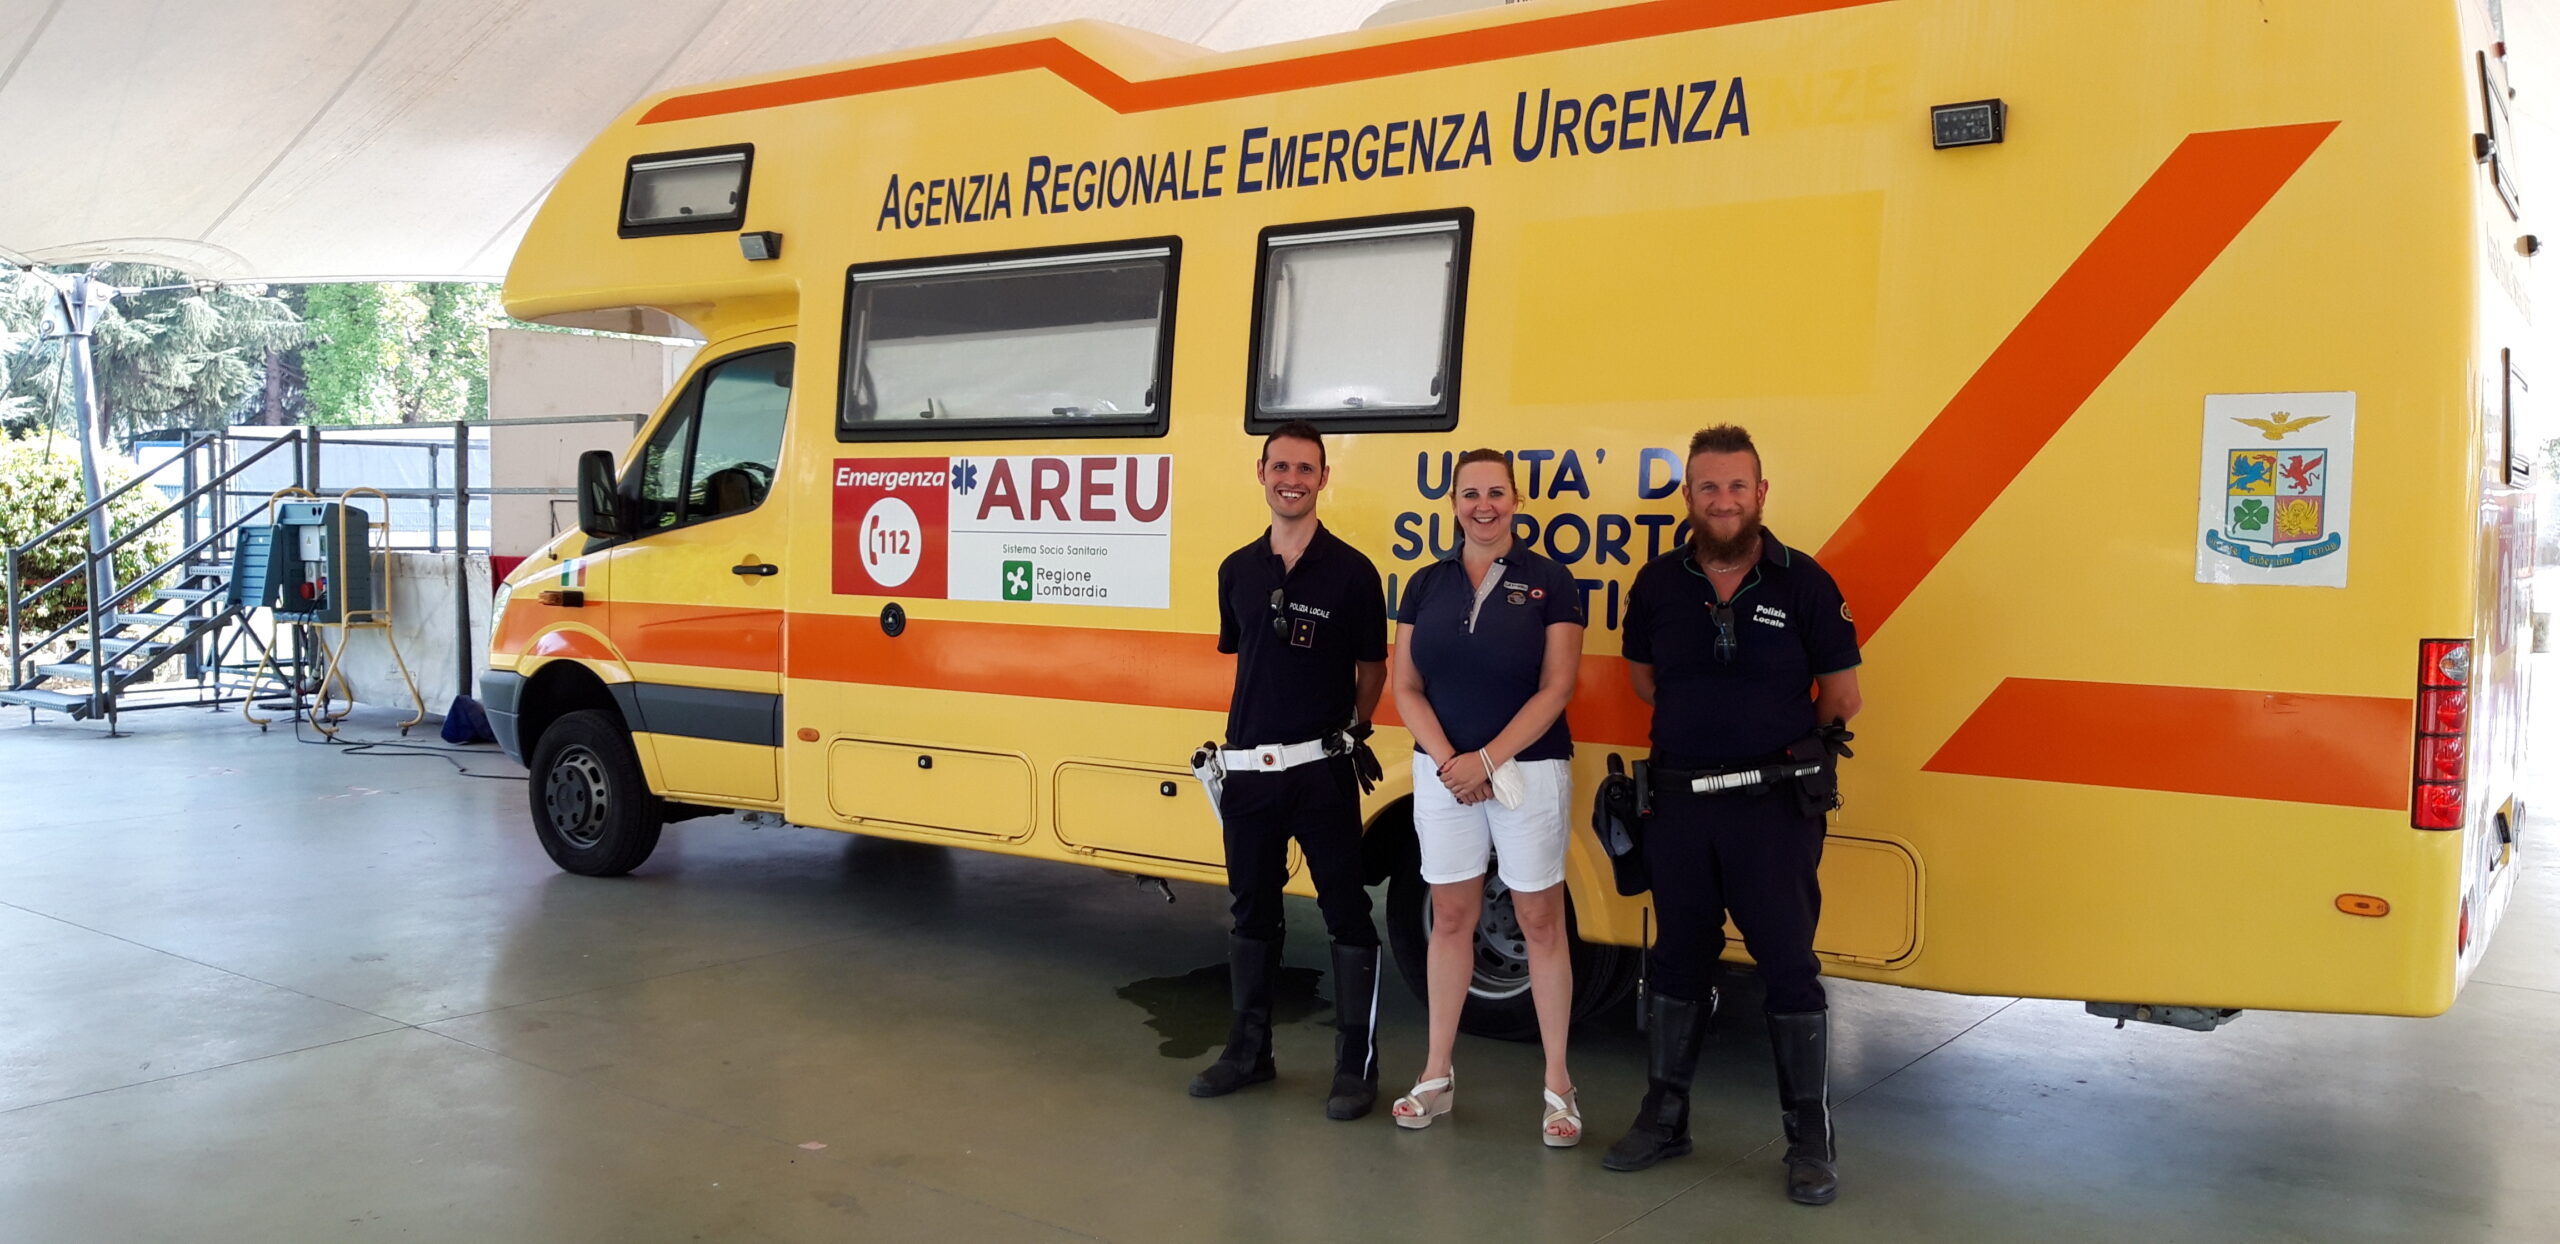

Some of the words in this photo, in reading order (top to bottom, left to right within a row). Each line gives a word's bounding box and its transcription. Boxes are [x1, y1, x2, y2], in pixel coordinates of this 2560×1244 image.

[836, 467, 946, 491] Emergenza
[1417, 448, 1606, 500] UTA'
[1638, 447, 1684, 499] D
[976, 456, 1171, 523] AREU
[878, 530, 911, 555] 112
[1393, 511, 1693, 565] SUPORT
[1003, 544, 1037, 554] Sistema
[1040, 544, 1064, 555] Socio
[1067, 545, 1108, 556] Sanitario
[1036, 567, 1092, 585] Regione
[1036, 584, 1108, 598] Lombardia
[1289, 602, 1309, 613] POLIZIA
[1309, 607, 1331, 619] LOCALE
[1756, 604, 1786, 619] Polizia
[1753, 614, 1785, 628] Locale
